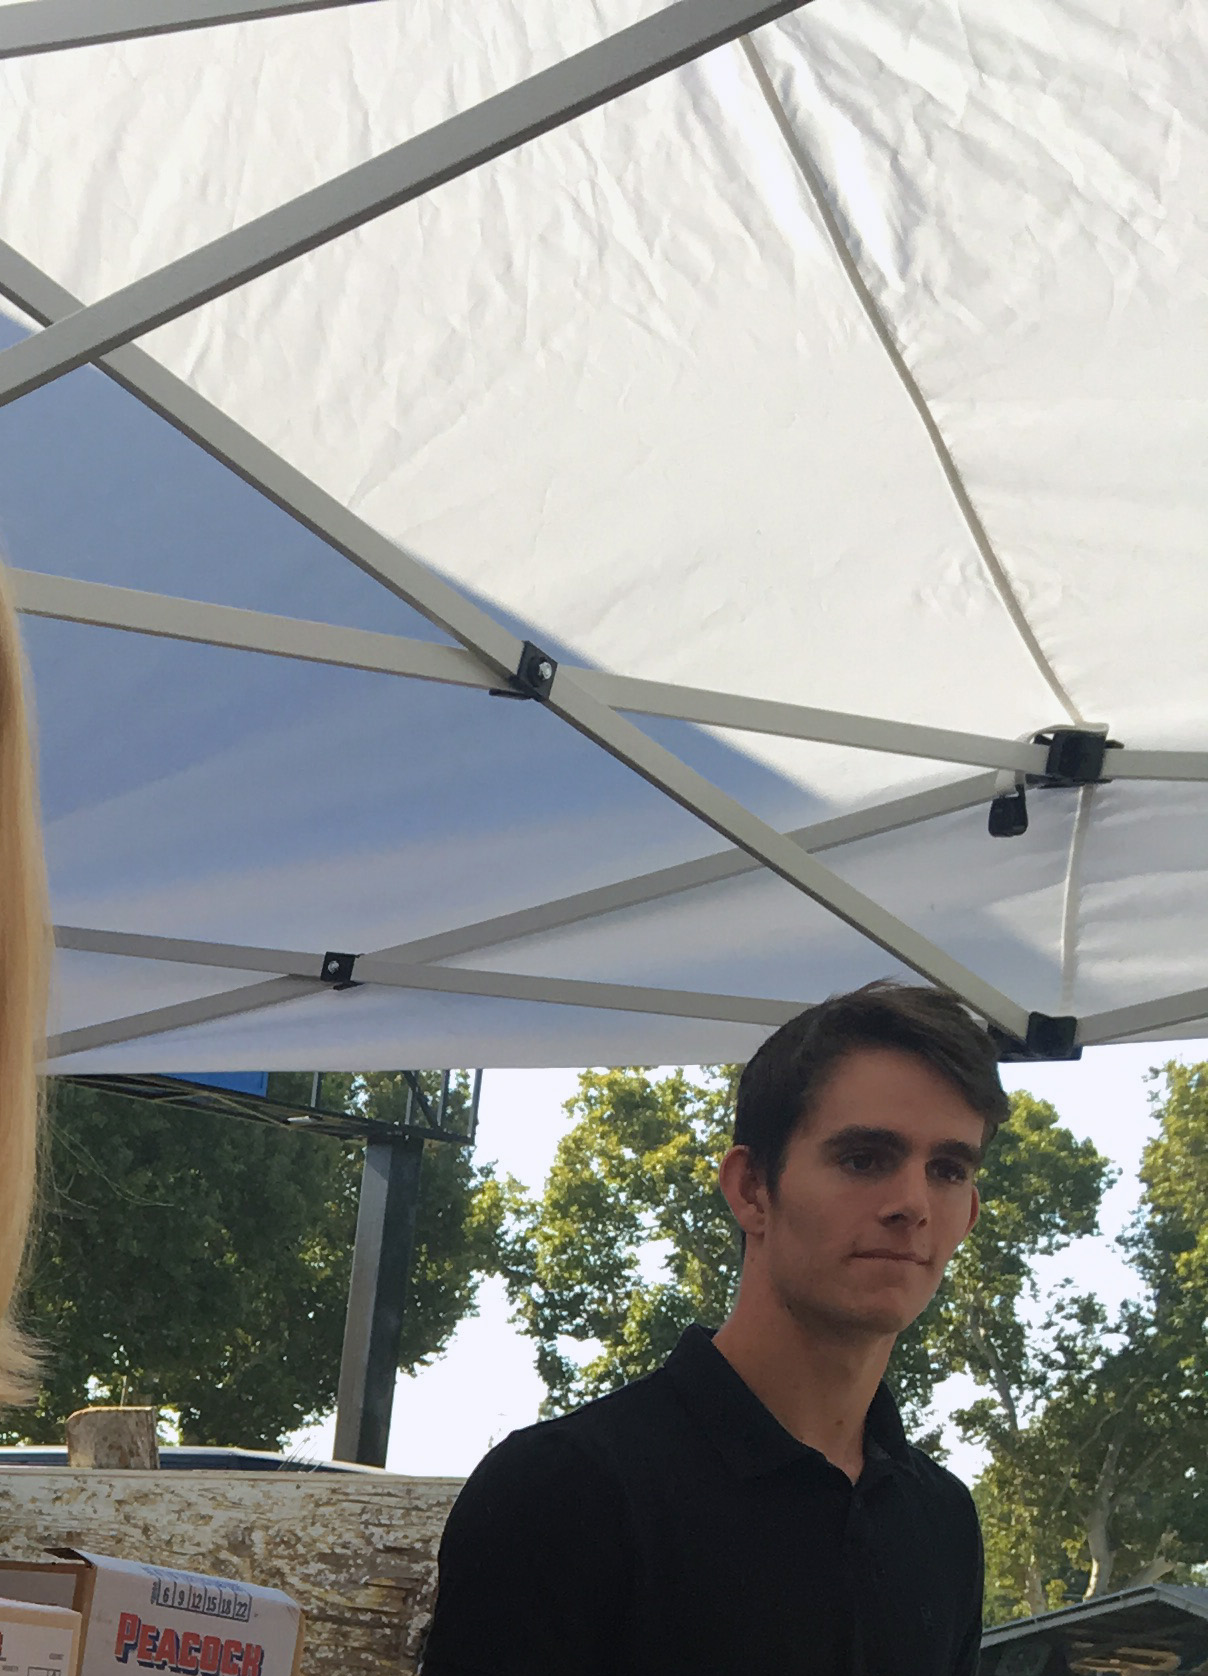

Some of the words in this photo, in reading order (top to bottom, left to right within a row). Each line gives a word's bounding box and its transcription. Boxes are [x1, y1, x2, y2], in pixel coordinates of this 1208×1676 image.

[162, 1587, 170, 1603] 6
[178, 1590, 185, 1606] 9
[192, 1593, 202, 1608] 12
[206, 1596, 217, 1612] 15
[221, 1598, 232, 1614] 18
[236, 1602, 248, 1618] 22
